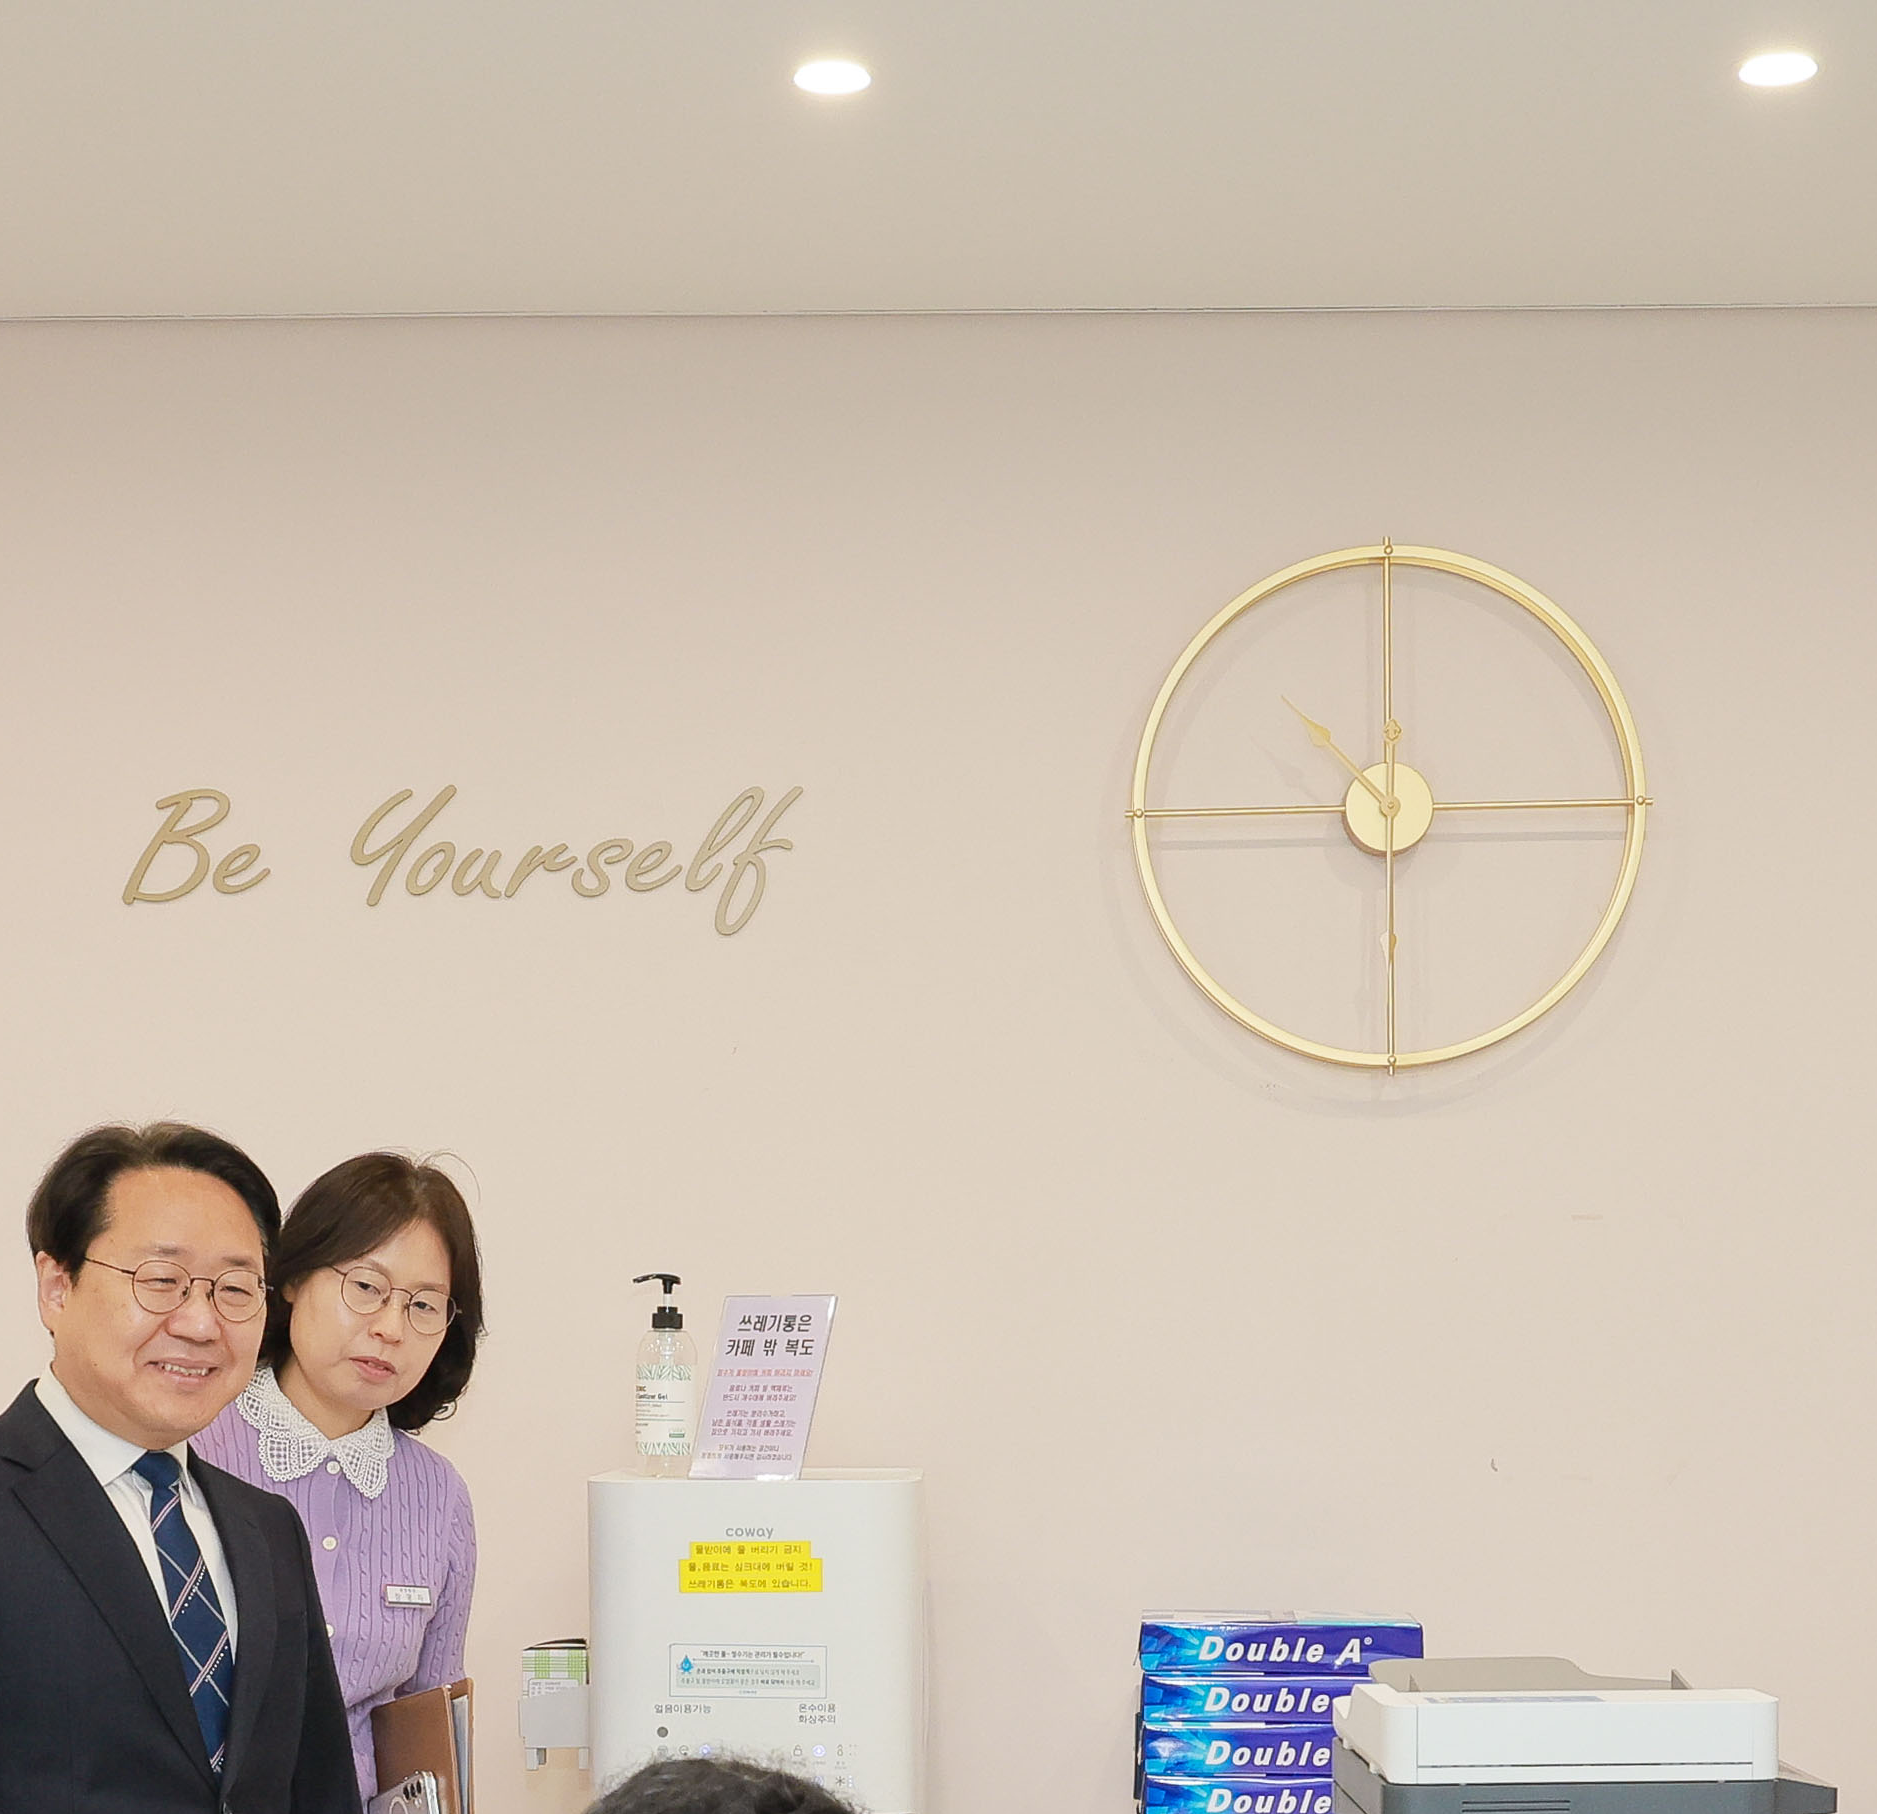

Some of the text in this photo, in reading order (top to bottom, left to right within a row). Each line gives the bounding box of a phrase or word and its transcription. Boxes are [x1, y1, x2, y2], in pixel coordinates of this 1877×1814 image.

[123, 785, 803, 936] Be Yourself
[737, 1314, 812, 1333] 쓰레기통은
[725, 1339, 815, 1357] 카페 밖 복도
[725, 1527, 774, 1539] coway
[695, 1545, 731, 1555] 물받이에
[751, 1545, 778, 1554] 버리기
[1198, 1635, 1325, 1663] Double
[798, 1703, 836, 1714] 온수이용
[1203, 1687, 1330, 1713] Double
[798, 1715, 836, 1724] 화상주의
[1205, 1740, 1331, 1767] Double
[1206, 1788, 1332, 1814] Double
